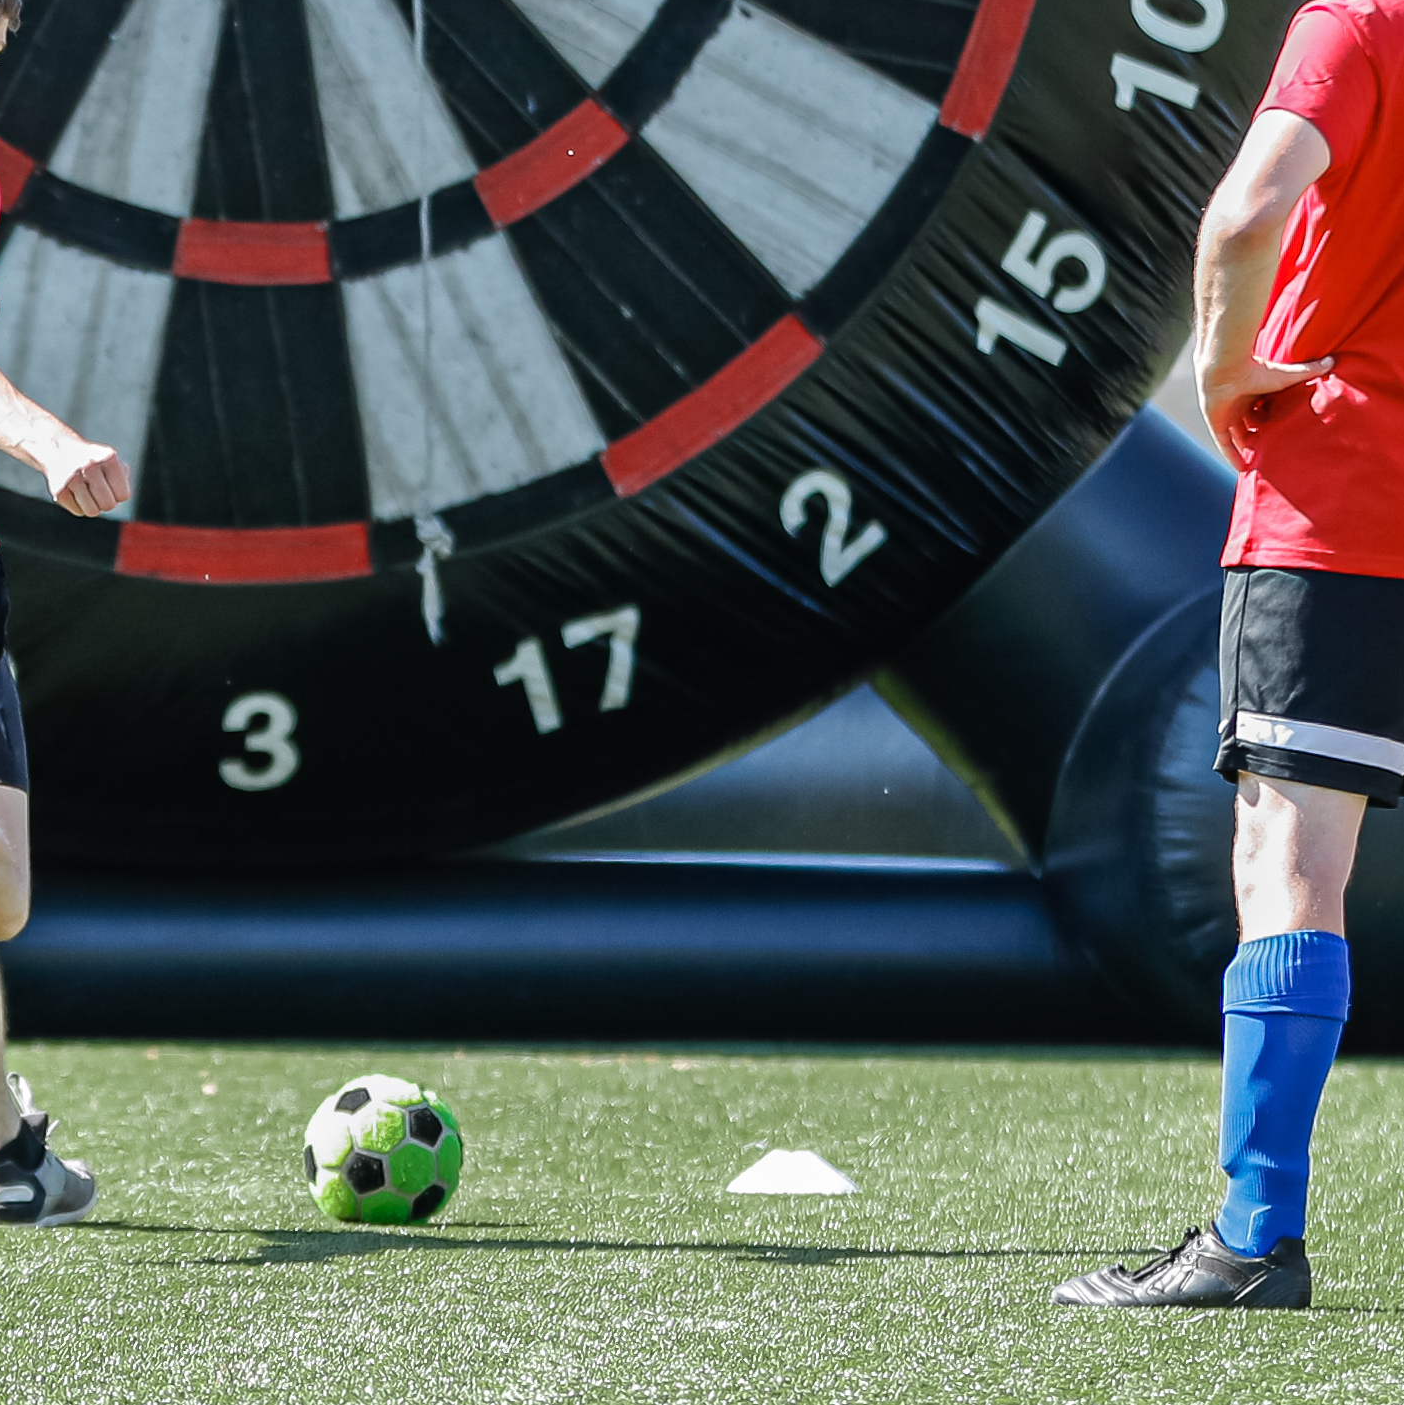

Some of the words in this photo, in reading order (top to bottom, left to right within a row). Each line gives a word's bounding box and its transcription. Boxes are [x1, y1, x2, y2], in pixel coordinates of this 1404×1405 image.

[973, 209, 1108, 368] 15
[778, 468, 886, 588] 2
[492, 605, 642, 735] 17
[219, 691, 300, 792] 3
